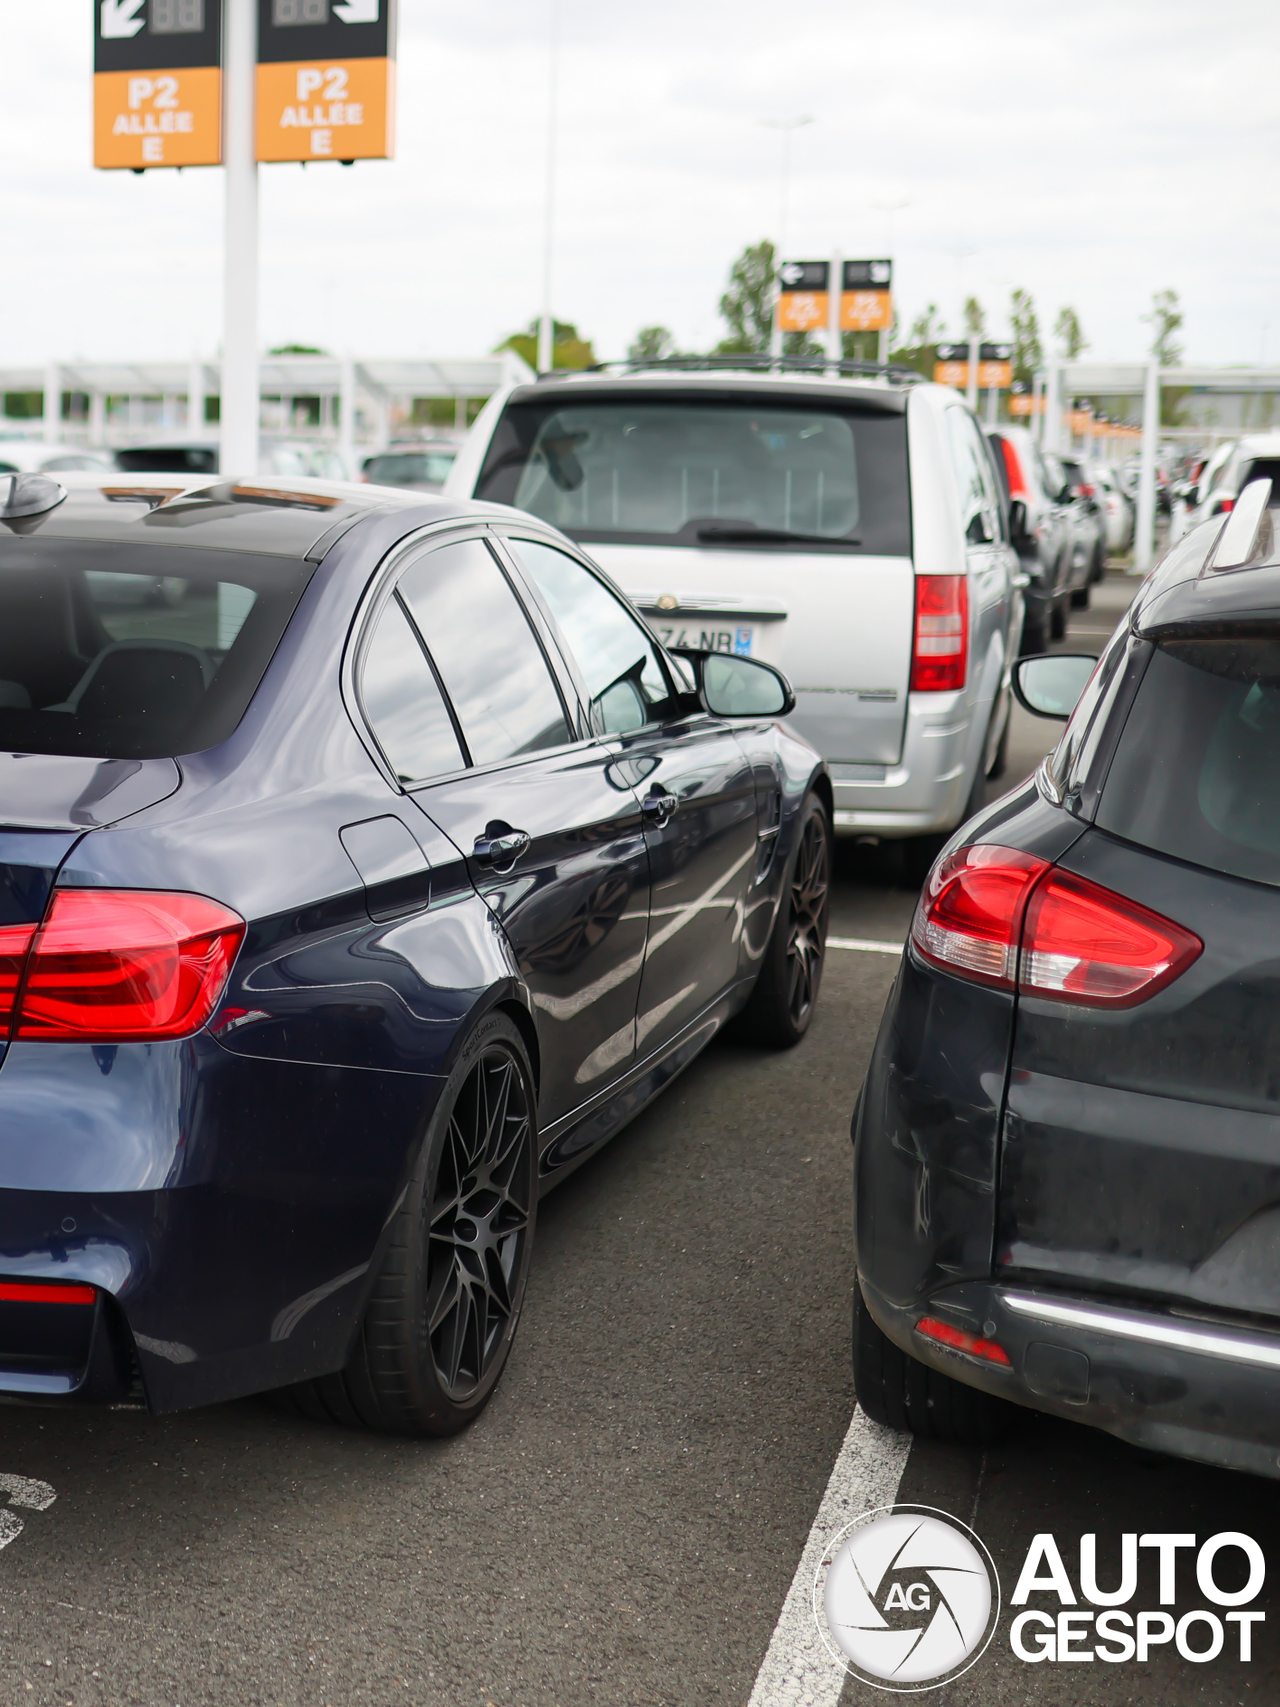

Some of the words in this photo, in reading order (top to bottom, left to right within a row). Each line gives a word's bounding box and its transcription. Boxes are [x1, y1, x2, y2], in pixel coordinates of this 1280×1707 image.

[128, 76, 179, 109] P2
[296, 67, 349, 101] P2
[113, 110, 194, 135] ALLÉE
[280, 102, 364, 128] ALLÉE
[142, 137, 164, 161] E
[311, 129, 333, 154] E
